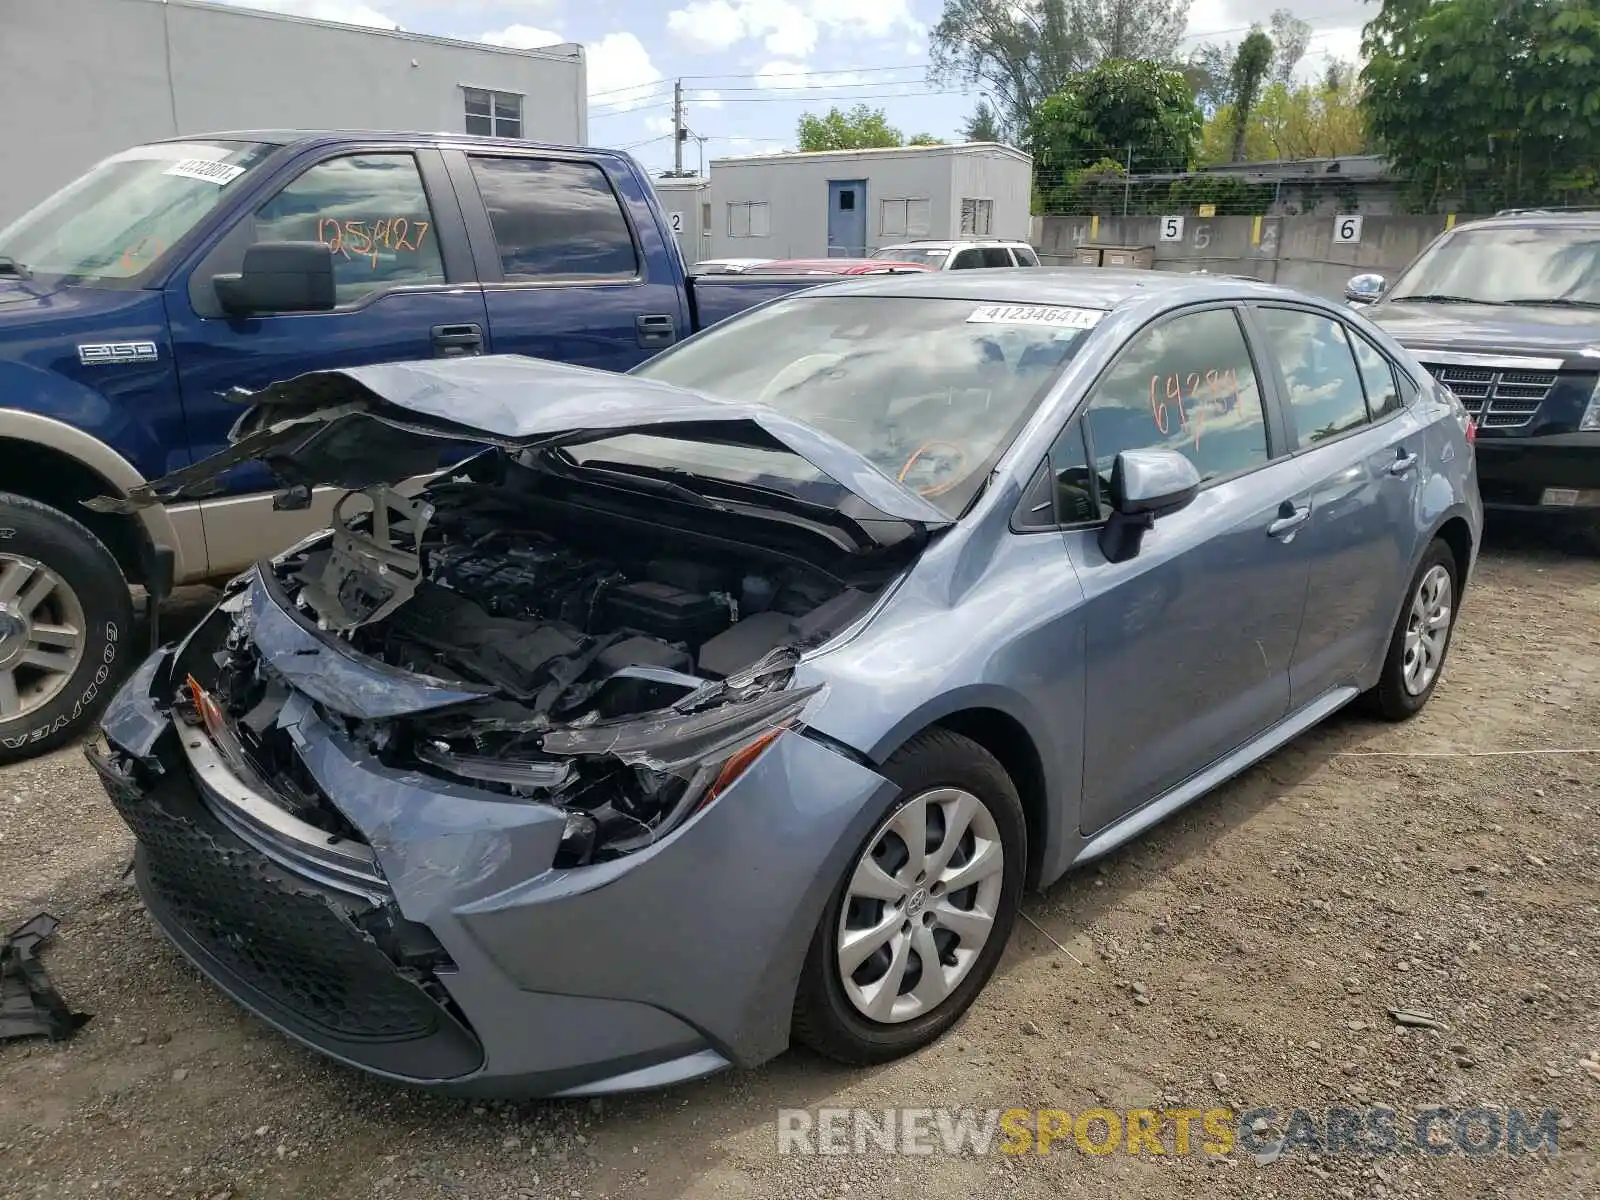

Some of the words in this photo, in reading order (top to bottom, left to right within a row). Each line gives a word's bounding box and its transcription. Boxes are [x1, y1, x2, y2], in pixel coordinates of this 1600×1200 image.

[672, 214, 681, 231] 2
[1165, 219, 1177, 238] 5
[1340, 219, 1355, 239] 6
